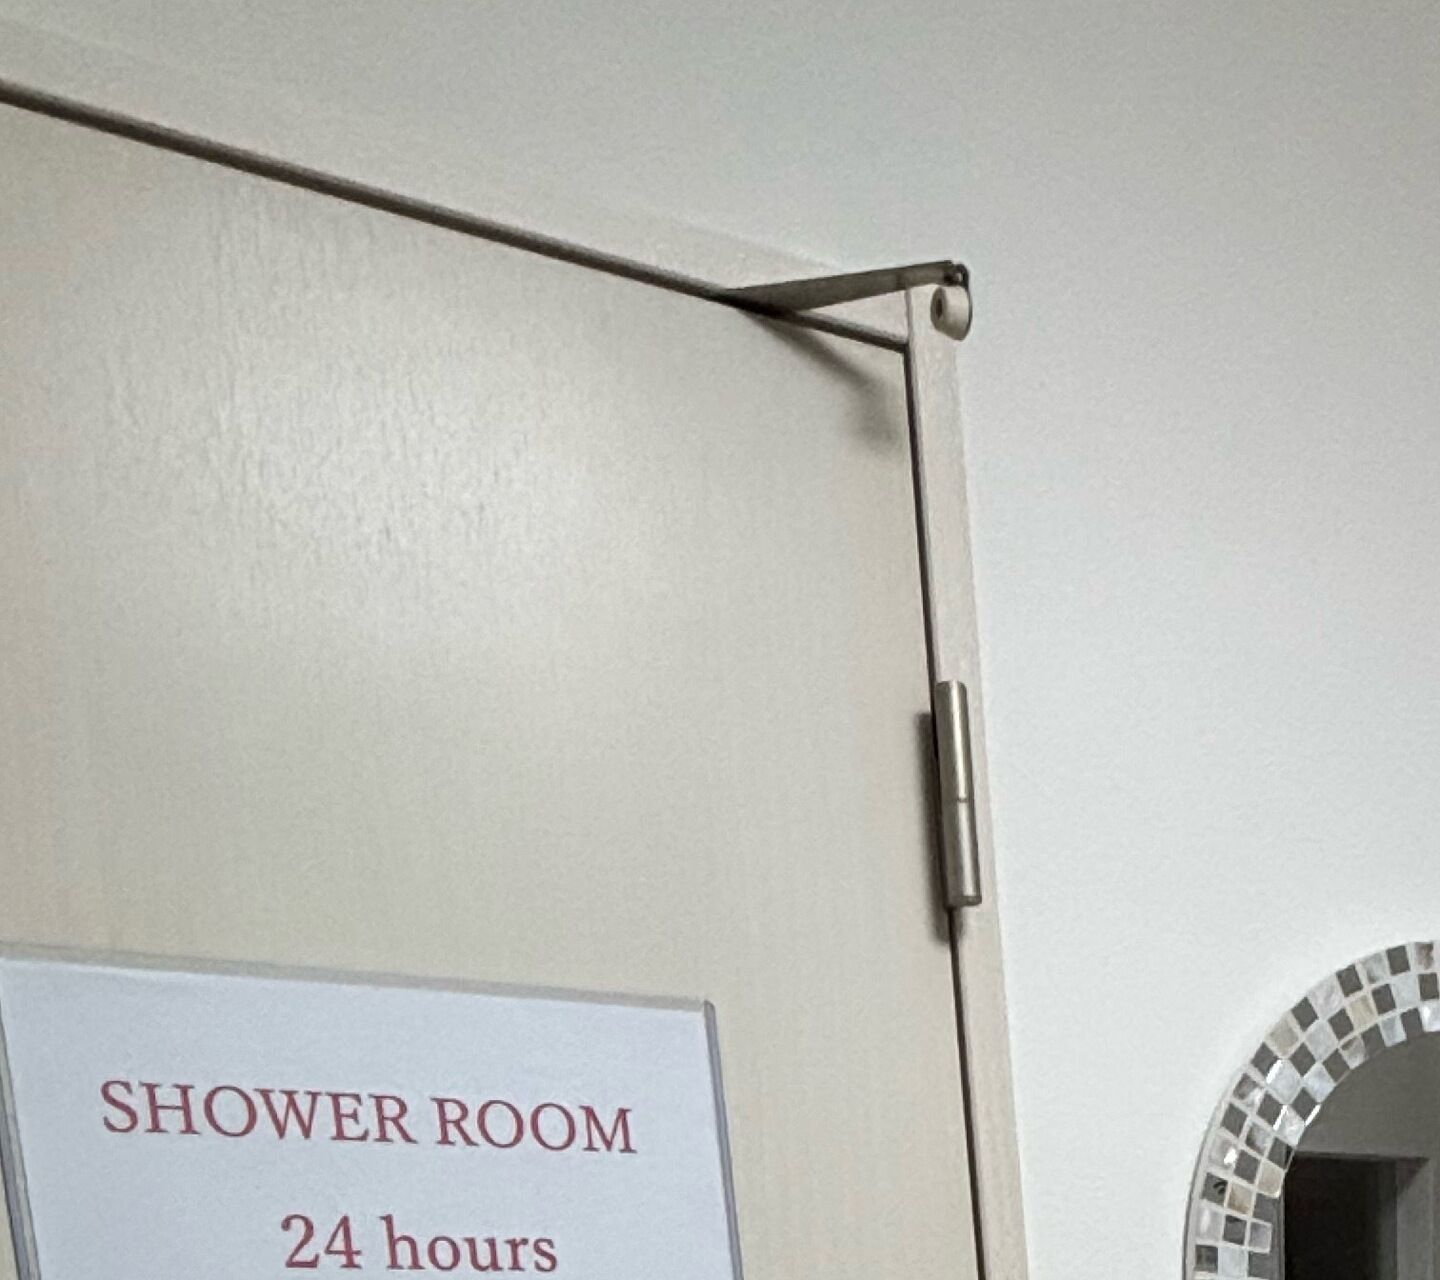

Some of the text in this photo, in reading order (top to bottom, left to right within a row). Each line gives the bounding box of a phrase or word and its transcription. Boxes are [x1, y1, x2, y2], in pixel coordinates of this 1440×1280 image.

[101, 1079, 638, 1154] SHOWER ROOM
[281, 1214, 559, 1273] 24 hours
